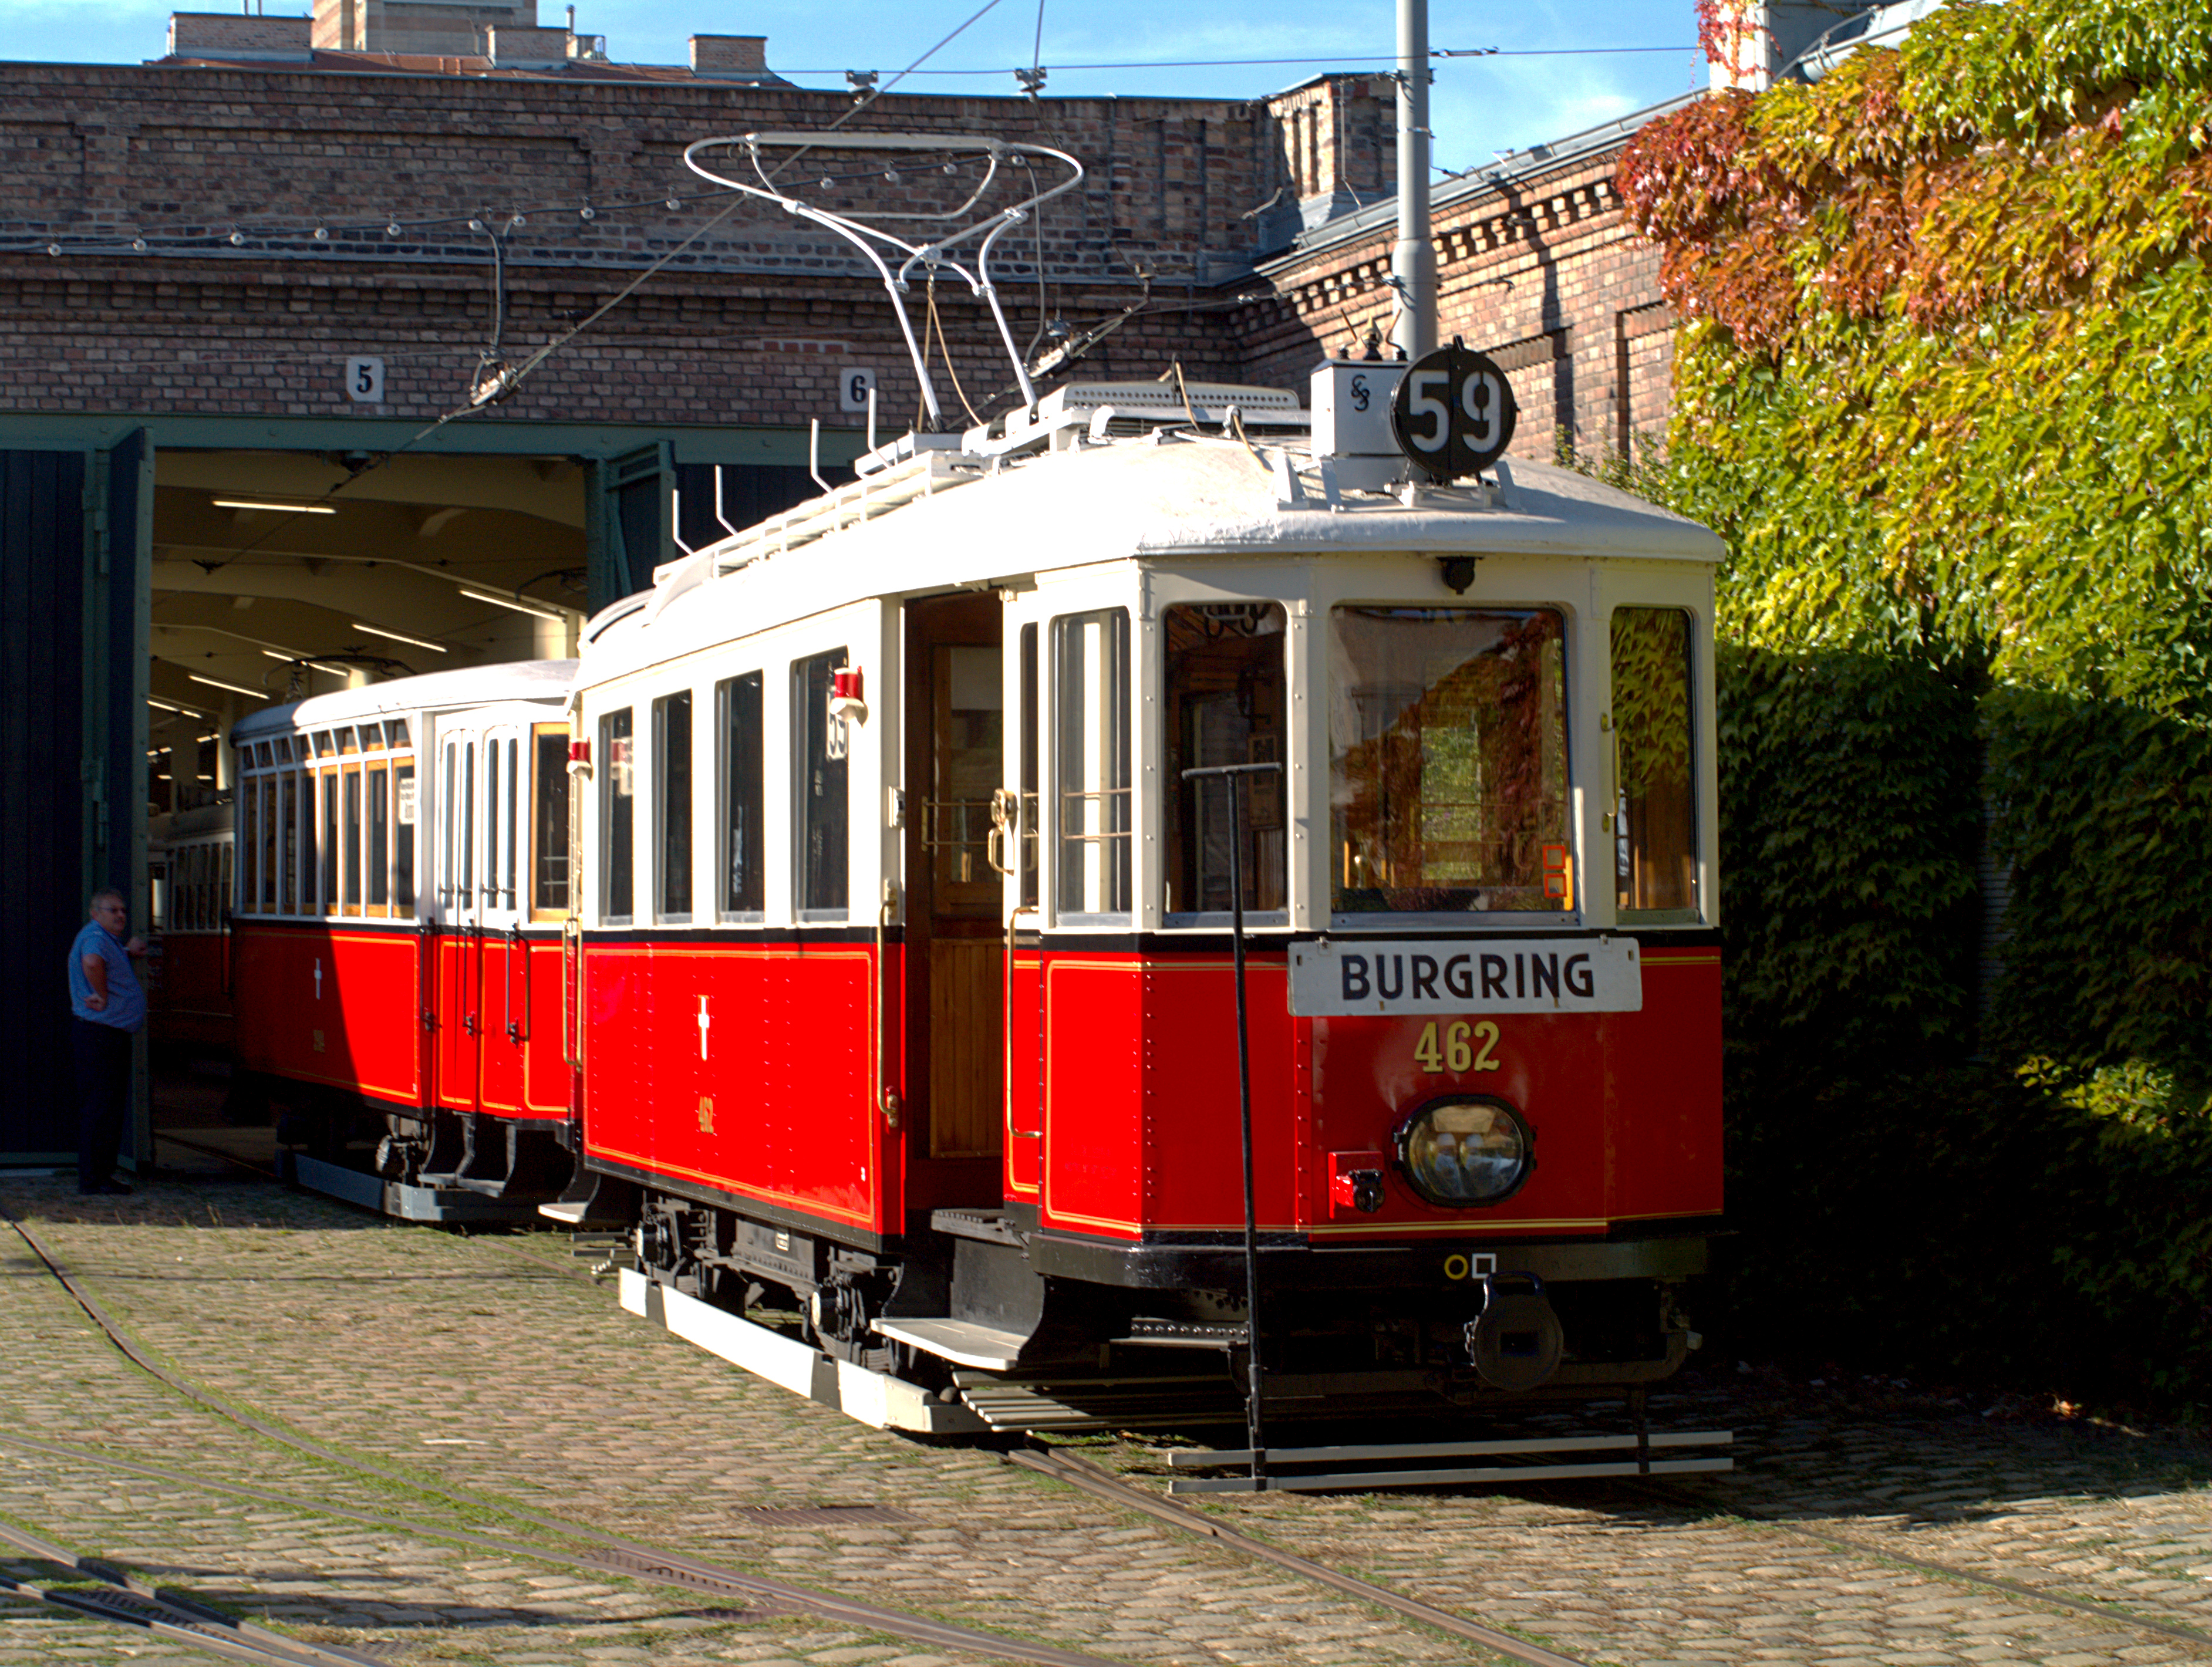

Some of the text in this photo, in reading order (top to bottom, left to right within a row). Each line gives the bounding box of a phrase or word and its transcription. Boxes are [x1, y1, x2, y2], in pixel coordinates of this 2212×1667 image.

[356, 365, 372, 393] 5
[851, 375, 866, 403] 6
[1409, 369, 1502, 454] 59
[1341, 953, 1594, 1001] BURGRING
[1414, 1020, 1500, 1073] 462
